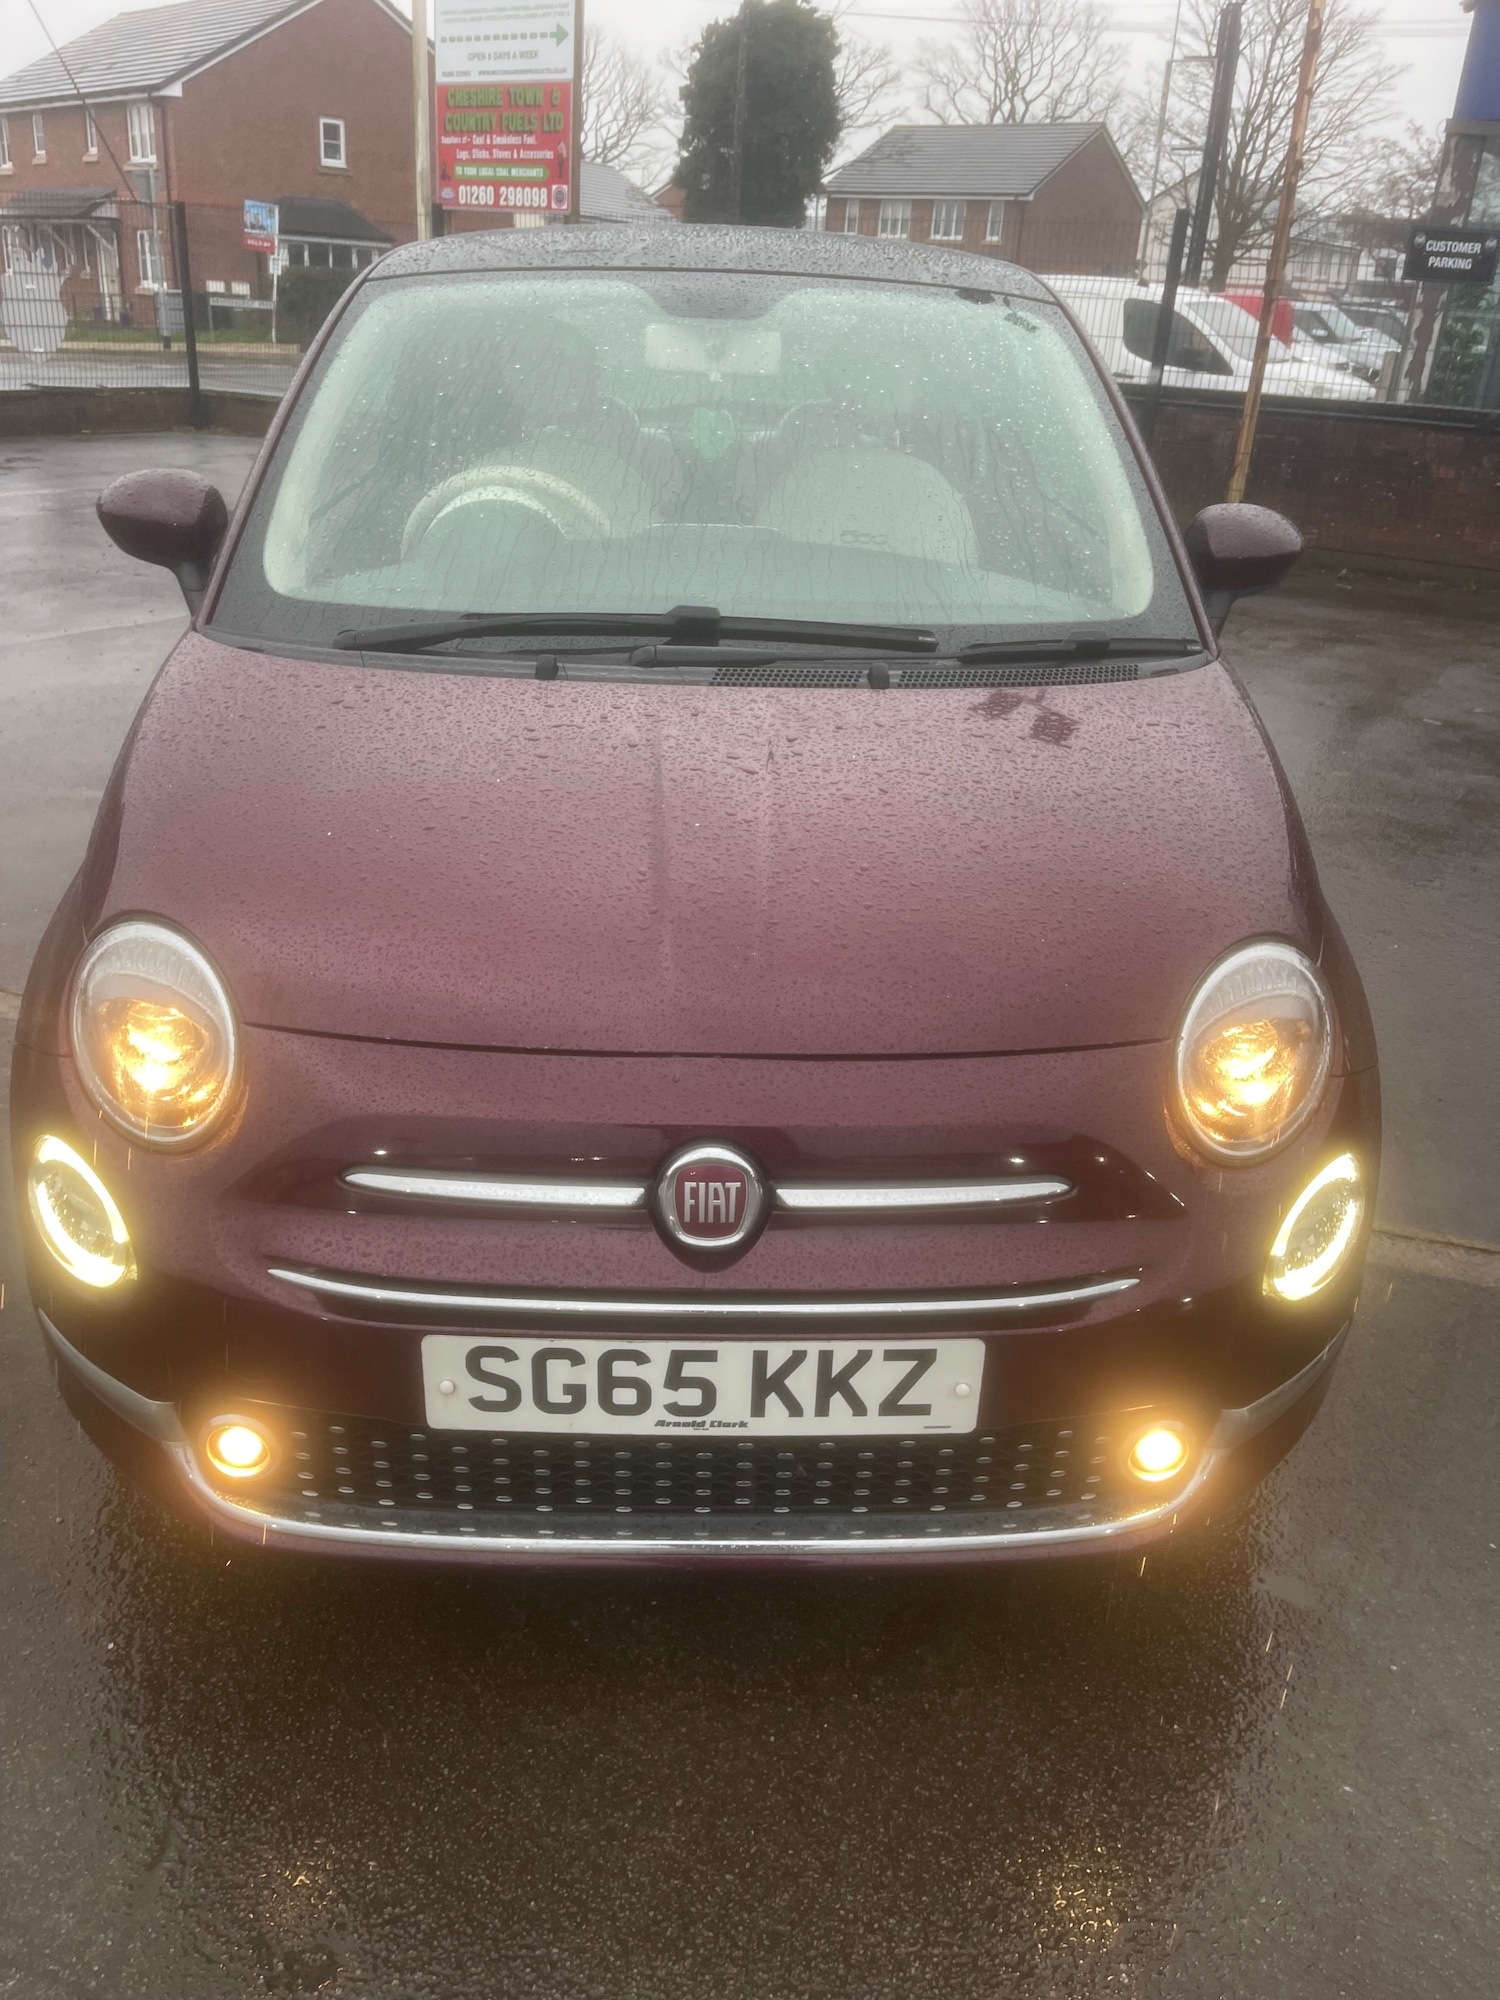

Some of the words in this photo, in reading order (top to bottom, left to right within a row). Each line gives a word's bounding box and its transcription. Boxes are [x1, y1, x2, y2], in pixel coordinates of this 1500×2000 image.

[468, 52, 486, 61] OPEN
[488, 52, 492, 60] 6
[493, 51, 511, 60] DAYS
[512, 51, 518, 60] A
[519, 50, 539, 60] WEEK
[446, 87, 503, 107] CHESHIRE
[508, 86, 543, 106] TOWN
[444, 113, 497, 132] COUNTRY
[501, 112, 538, 132] FUELS
[542, 112, 563, 132] LTD
[472, 134, 486, 145] Coal
[486, 134, 491, 145] &
[492, 134, 522, 145] Smokeless
[492, 149, 511, 160] Stoves
[513, 149, 518, 159] &
[519, 149, 554, 160] Accessories
[464, 166, 477, 176] YOUR
[478, 167, 494, 177] LOCAL
[496, 167, 509, 177] COAL
[511, 167, 544, 178] MERCHANTS
[458, 185, 494, 205] 01260
[499, 186, 548, 208] 298098
[1426, 240, 1482, 254] CUSTOMER
[1428, 256, 1472, 270] PARKING
[683, 1181, 741, 1224] FIAT
[465, 1345, 719, 1418] SG65
[750, 1349, 938, 1418] KKZ
[654, 1419, 707, 1428] Arnold
[709, 1420, 749, 1429] Clark
